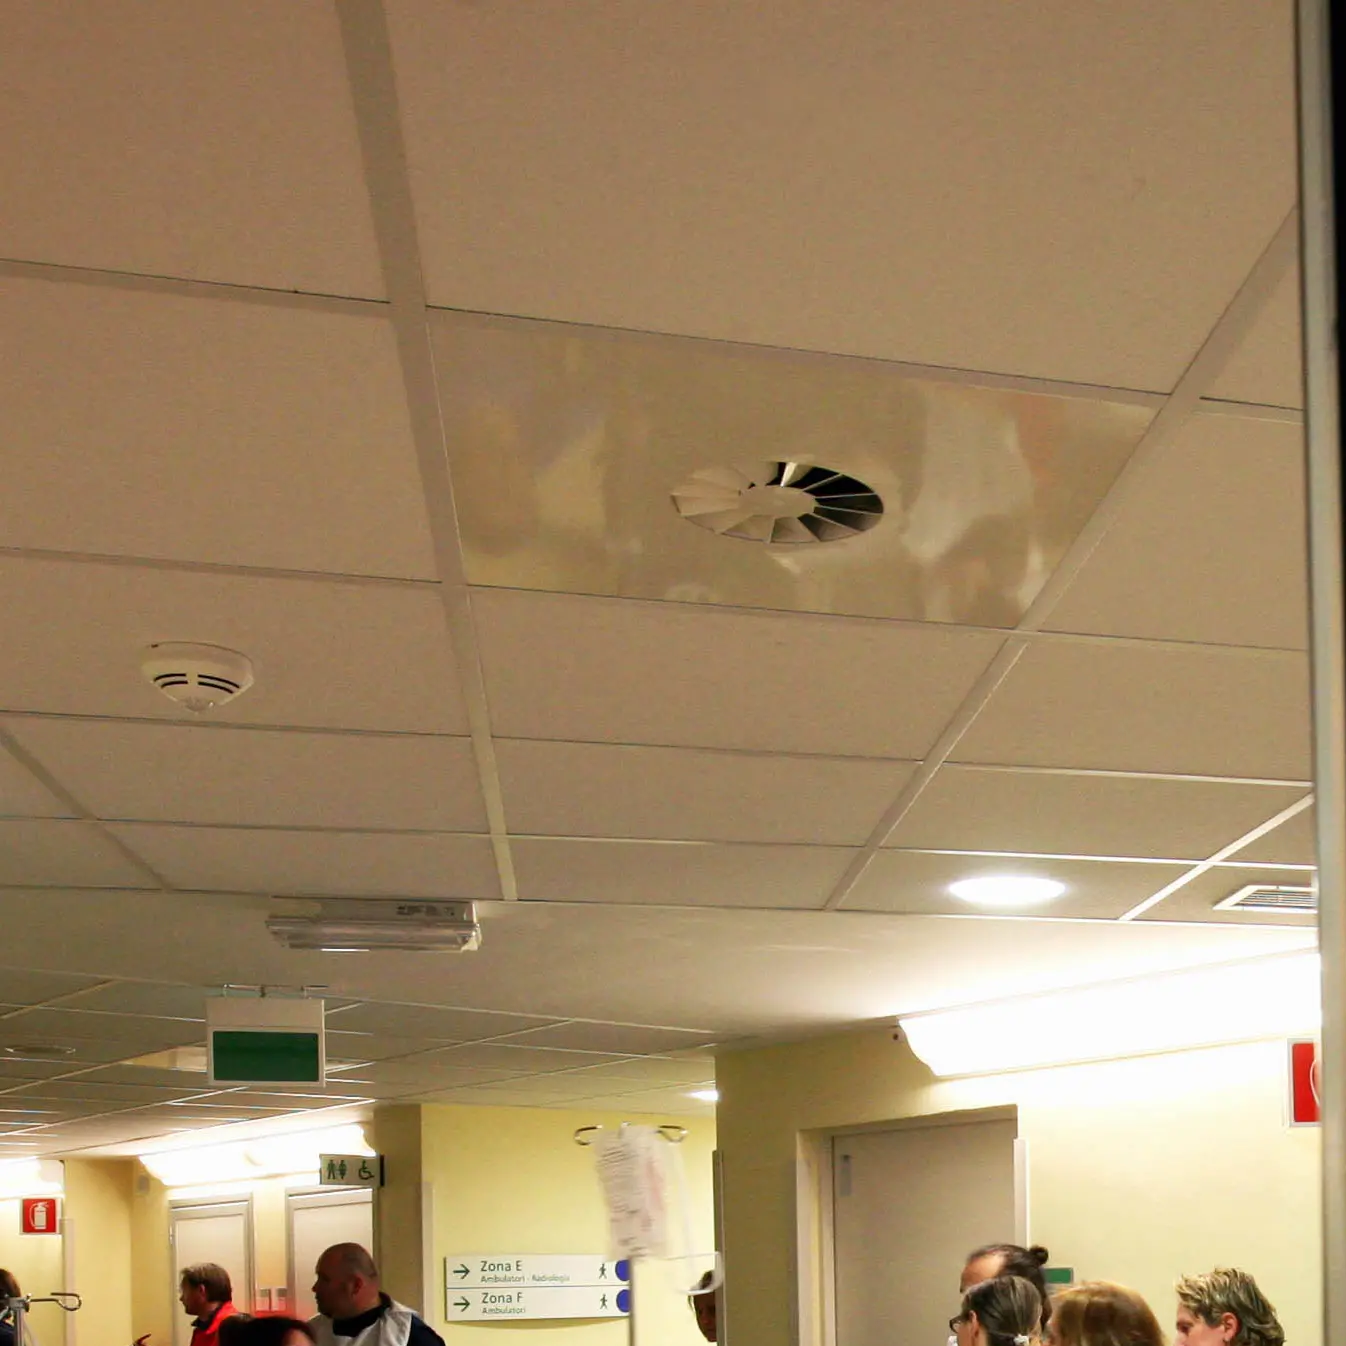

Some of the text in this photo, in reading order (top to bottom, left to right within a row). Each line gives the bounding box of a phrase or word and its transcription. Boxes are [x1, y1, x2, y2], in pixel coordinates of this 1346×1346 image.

[480, 1260, 522, 1272] Zona E
[480, 1275, 525, 1283] Ambulatori
[481, 1291, 523, 1304] Zona F
[482, 1307, 526, 1315] Ambulatori
